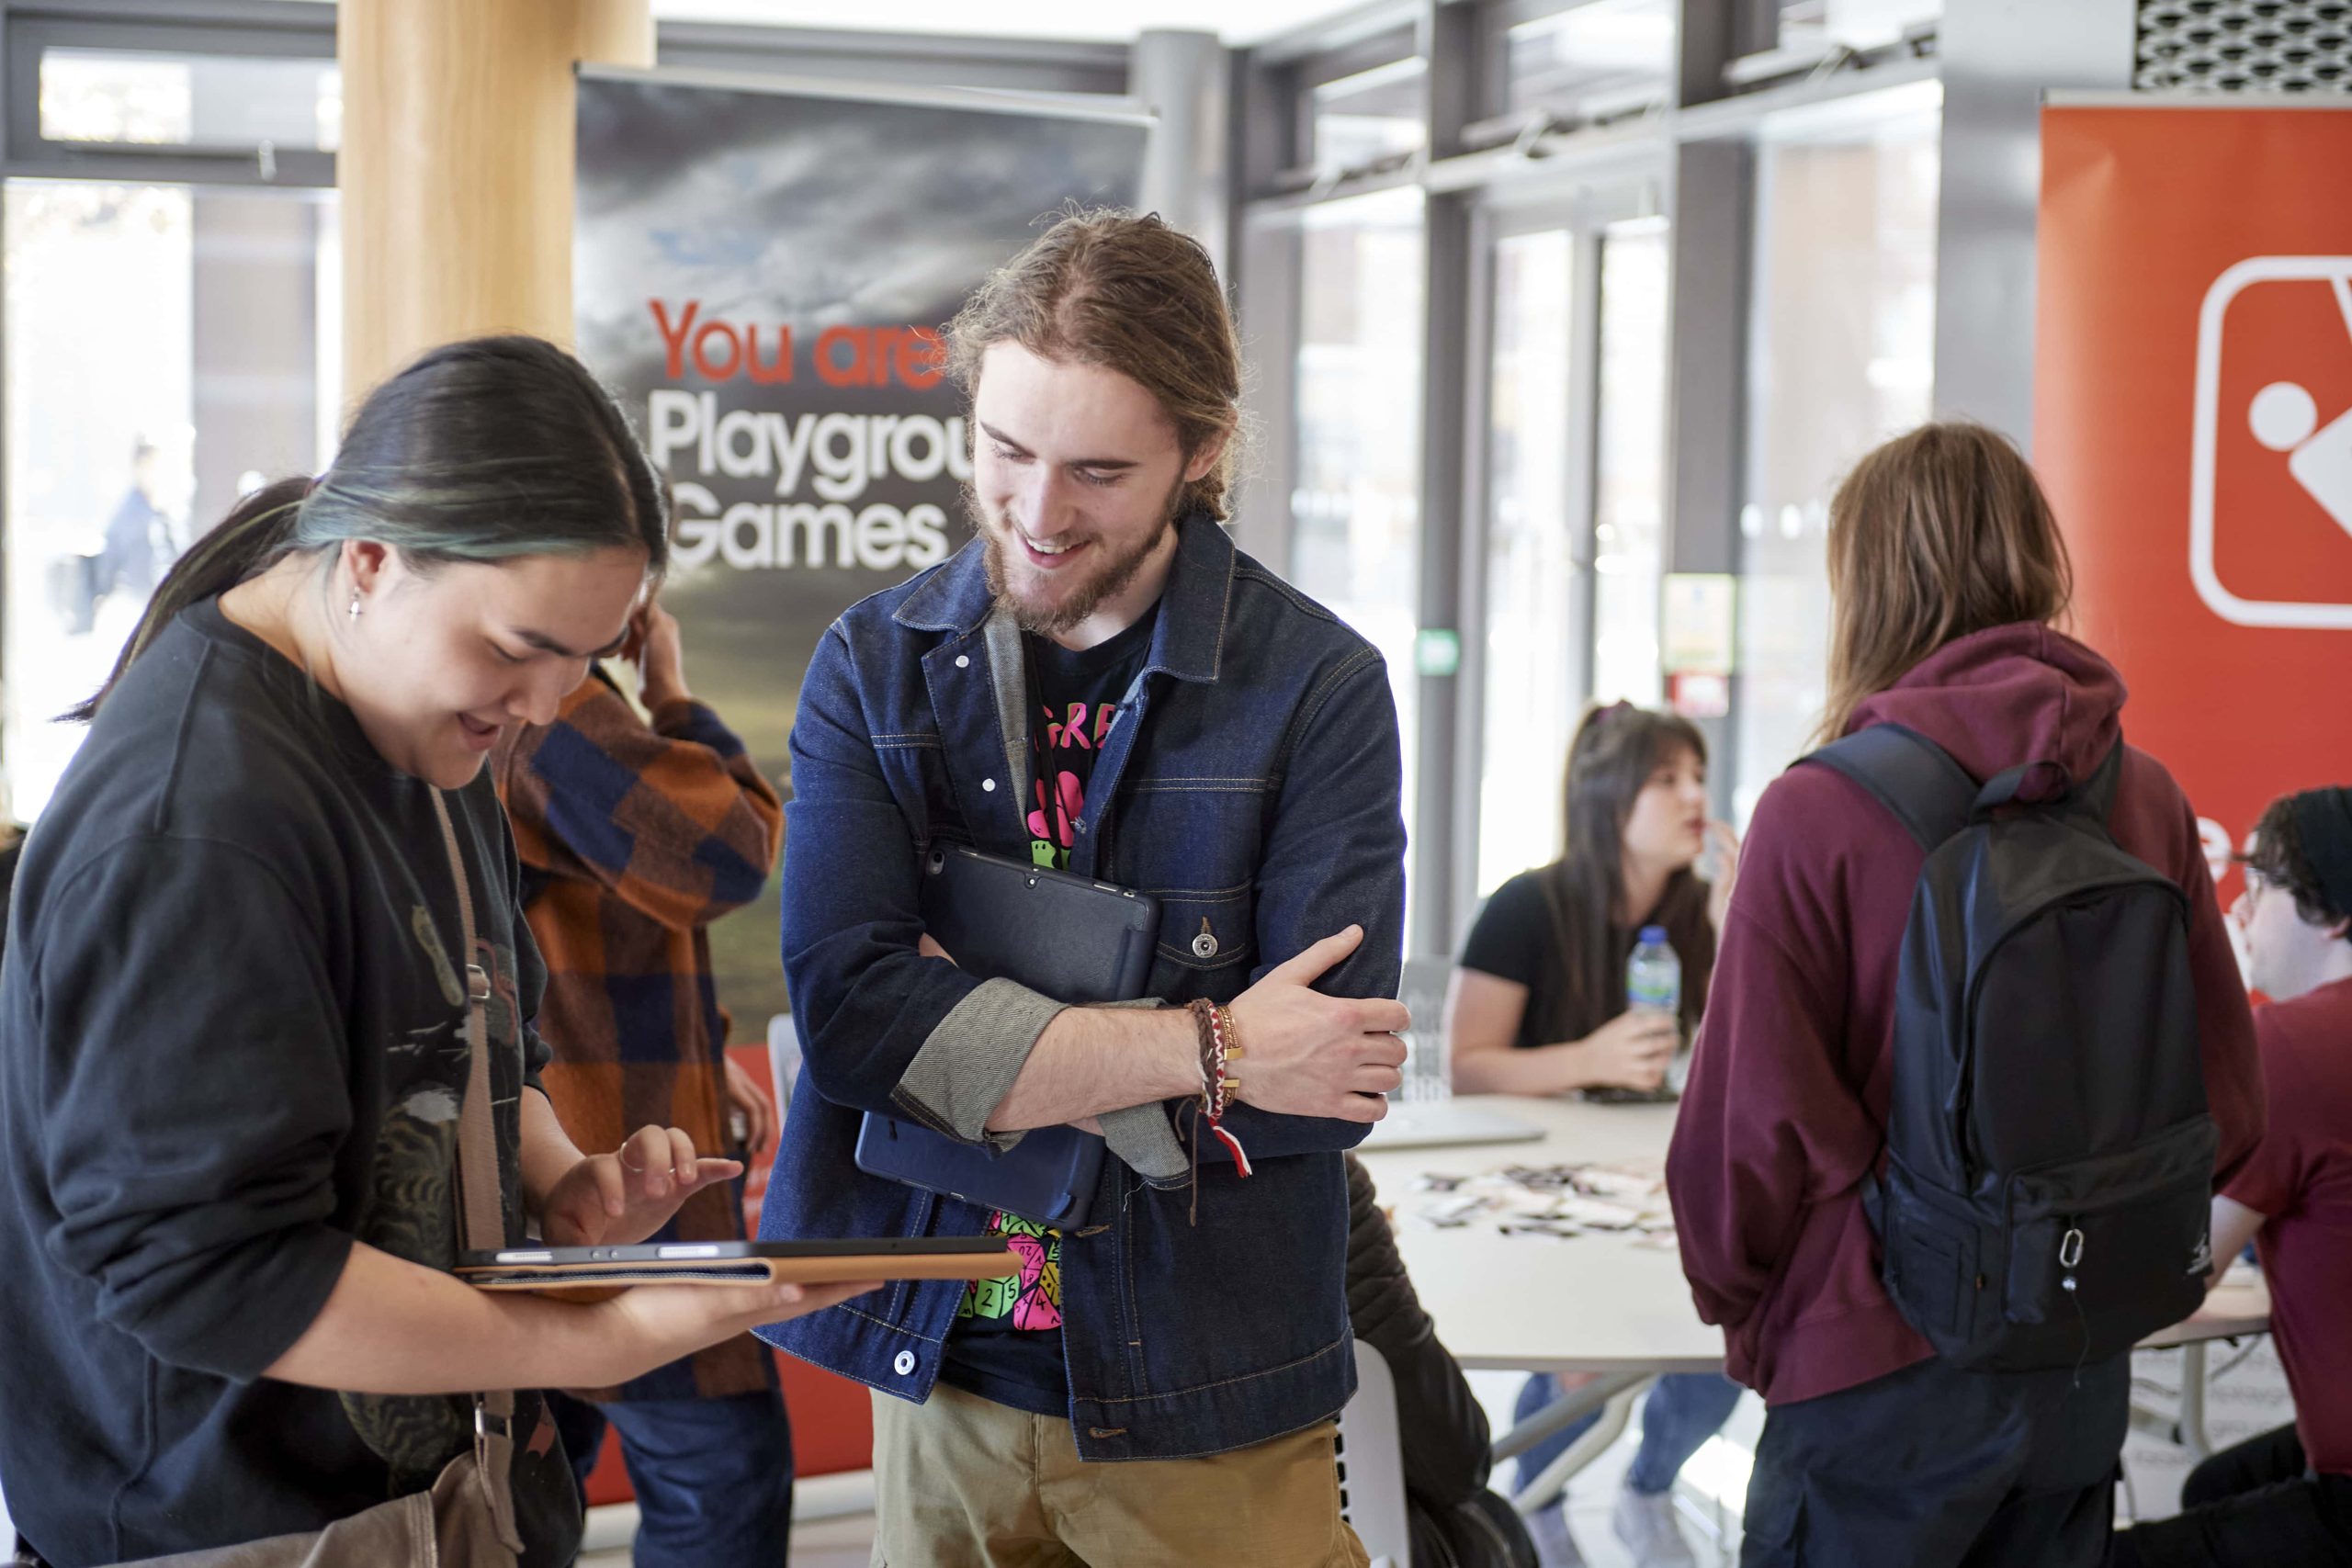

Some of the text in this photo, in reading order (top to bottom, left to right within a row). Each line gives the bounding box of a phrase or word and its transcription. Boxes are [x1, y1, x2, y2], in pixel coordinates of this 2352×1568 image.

[649, 299, 947, 390] You are
[668, 481, 949, 570] Games
[981, 1288, 993, 1308] 2
[1008, 1282, 1016, 1300] 5
[1035, 1292, 1046, 1311] 4
